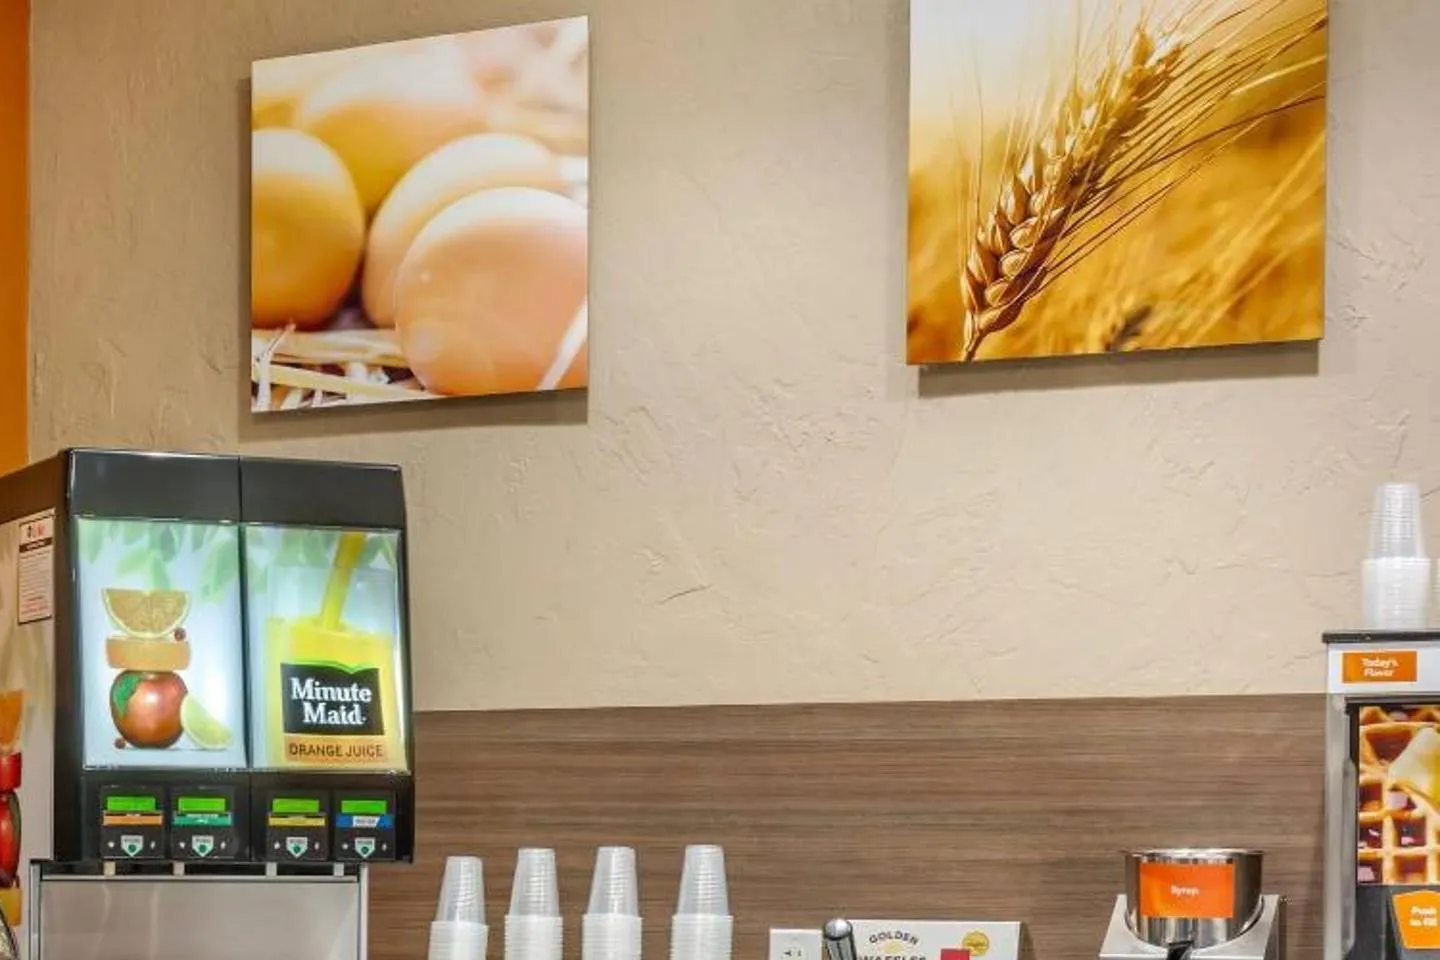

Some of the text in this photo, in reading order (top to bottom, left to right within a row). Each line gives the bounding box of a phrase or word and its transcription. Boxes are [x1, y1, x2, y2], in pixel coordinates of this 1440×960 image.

[290, 677, 372, 702] Minute
[302, 701, 364, 725] Maid
[289, 742, 384, 758] ORANGE JUICE
[869, 930, 918, 945] GOLDEN
